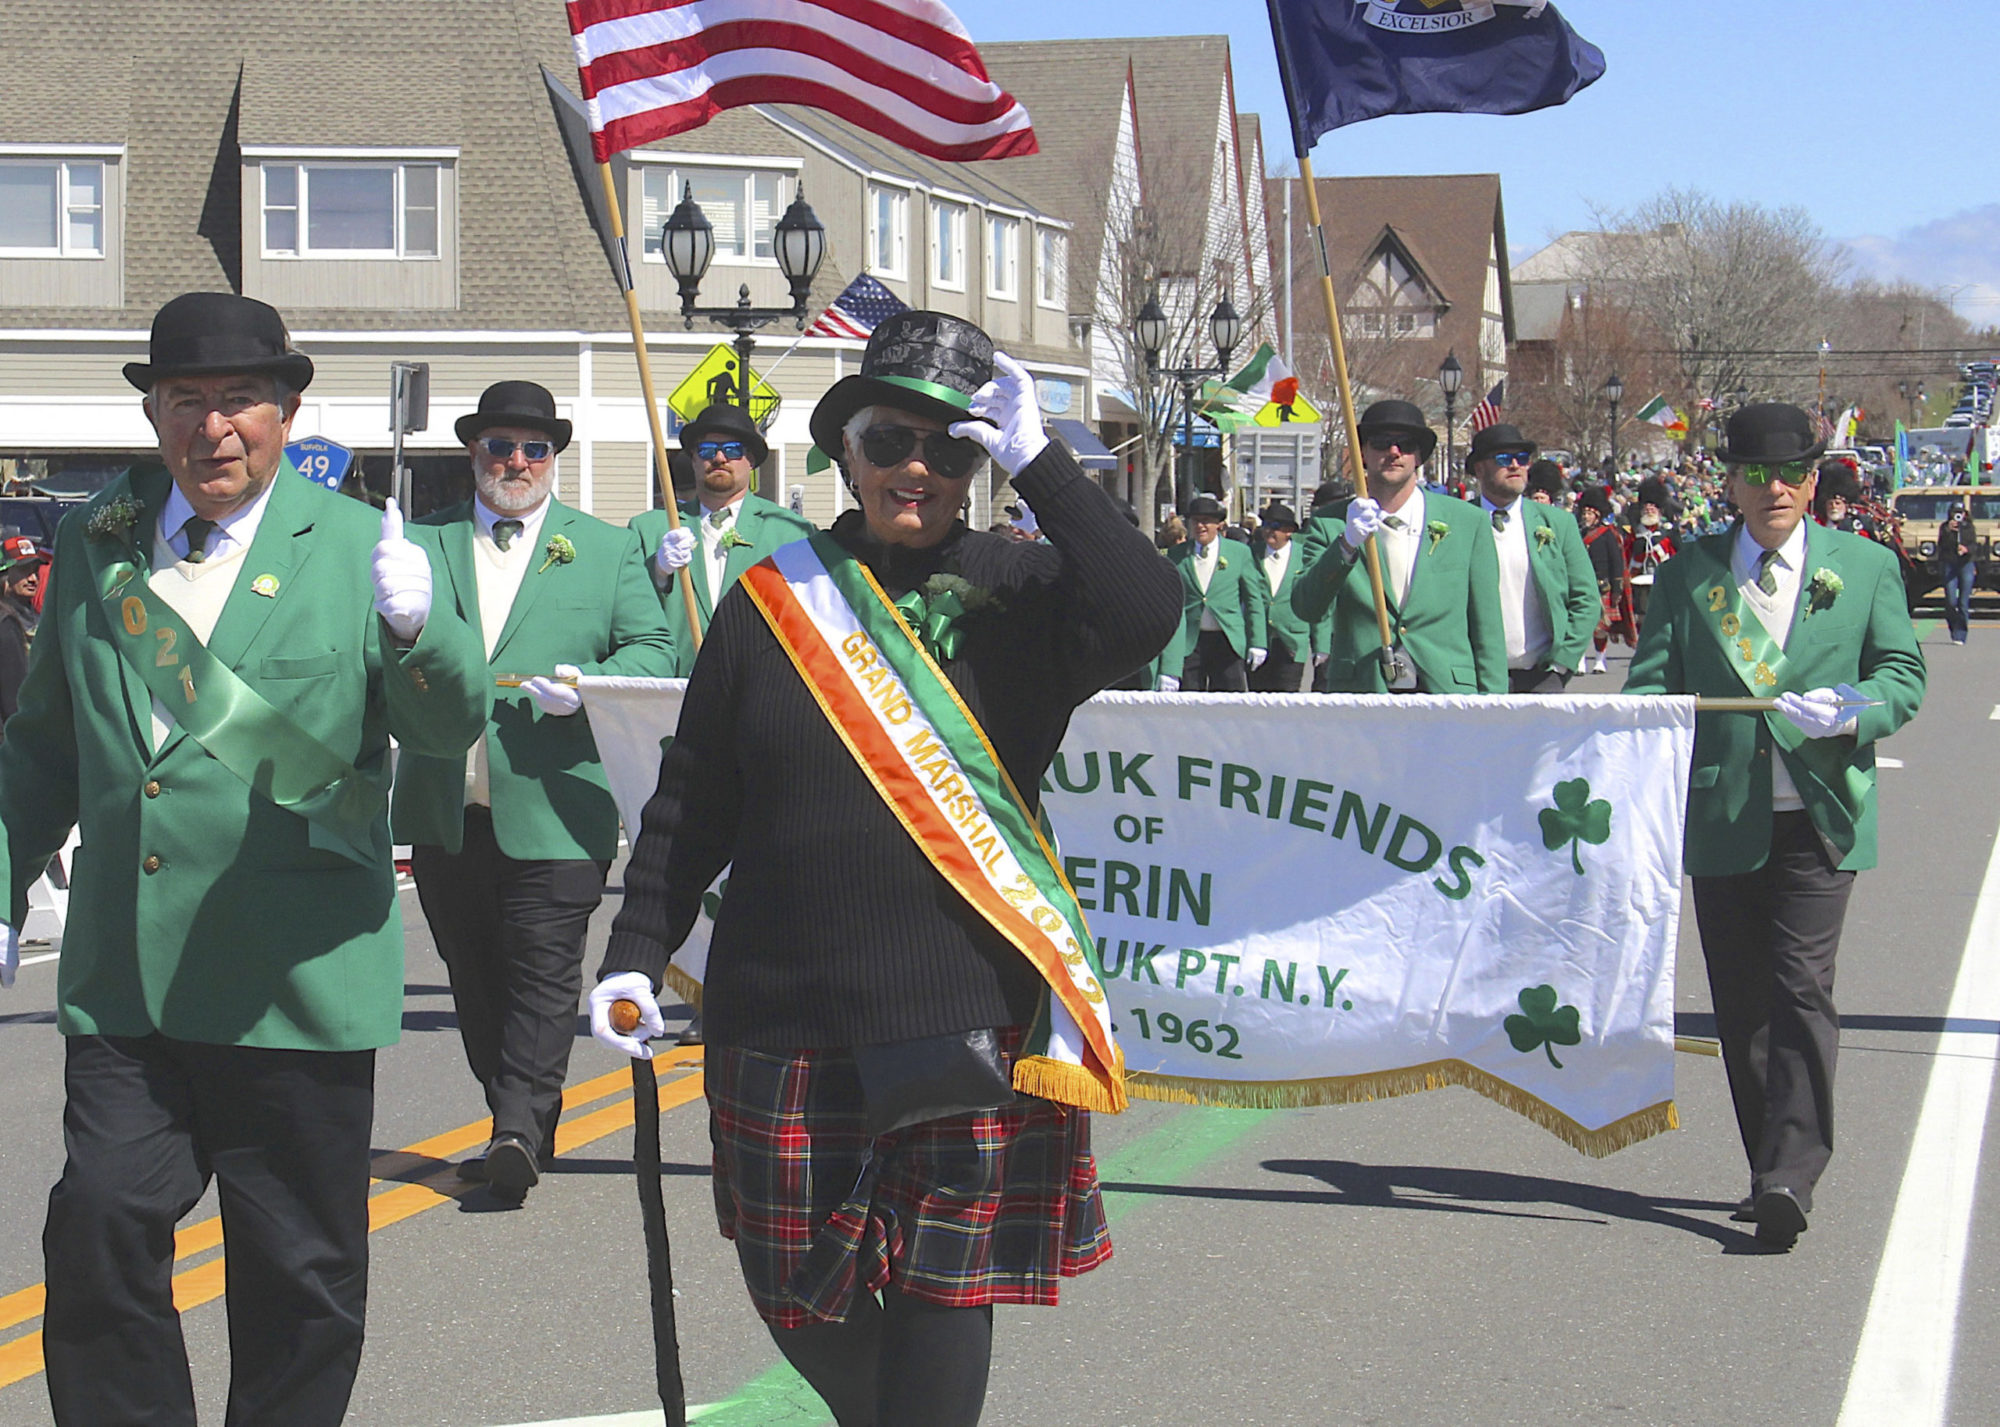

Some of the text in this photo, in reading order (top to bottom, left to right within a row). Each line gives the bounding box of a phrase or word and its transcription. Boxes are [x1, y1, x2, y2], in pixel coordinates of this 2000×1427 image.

[1378, 11, 1475, 30] EXCELSIOR
[297, 455, 330, 478] 49
[300, 443, 329, 452] SUFFOLK
[842, 631, 1104, 1014] GRAND MARSHAL 2022
[1039, 750, 1486, 901] UK FRIENDS
[1113, 813, 1163, 844] OF
[1064, 856, 1212, 926] ERIN
[1175, 949, 1244, 996] PT.
[1130, 1008, 1243, 1059] 1962
